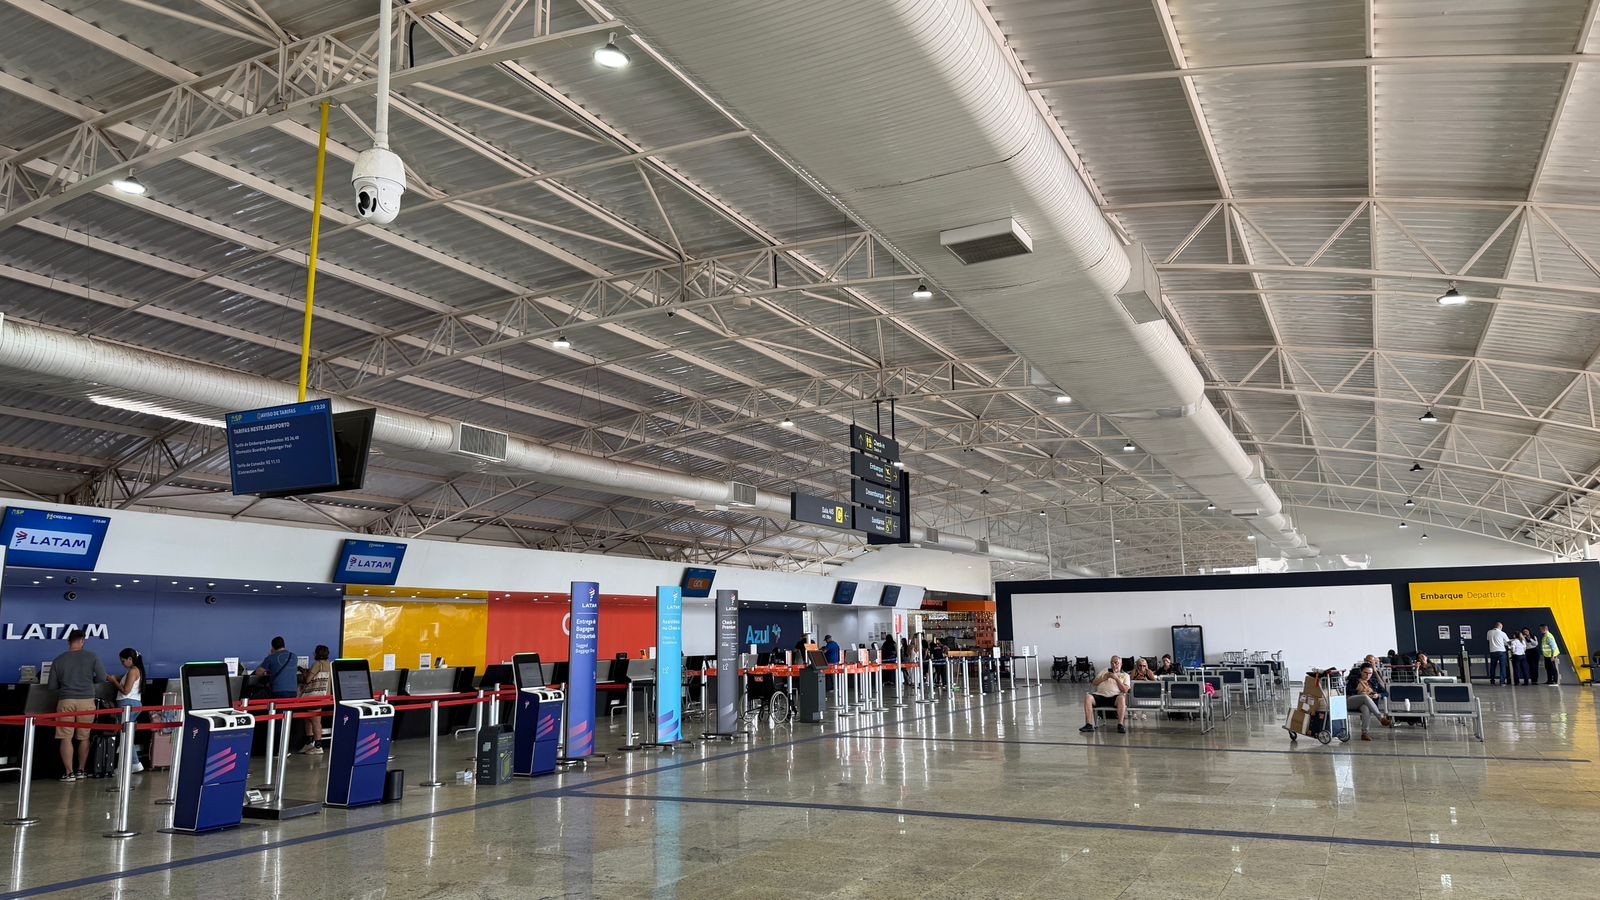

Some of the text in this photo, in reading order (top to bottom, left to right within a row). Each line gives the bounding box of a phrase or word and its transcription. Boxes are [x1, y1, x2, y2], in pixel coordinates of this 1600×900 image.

[279, 408, 296, 416] TARIFAS
[250, 425, 264, 433] NESTE
[264, 421, 290, 431] AEROPORTO
[30, 536, 86, 548] LATAM
[358, 560, 391, 568] LATAM
[6, 623, 109, 640] LATAM
[745, 624, 770, 644] Azul
